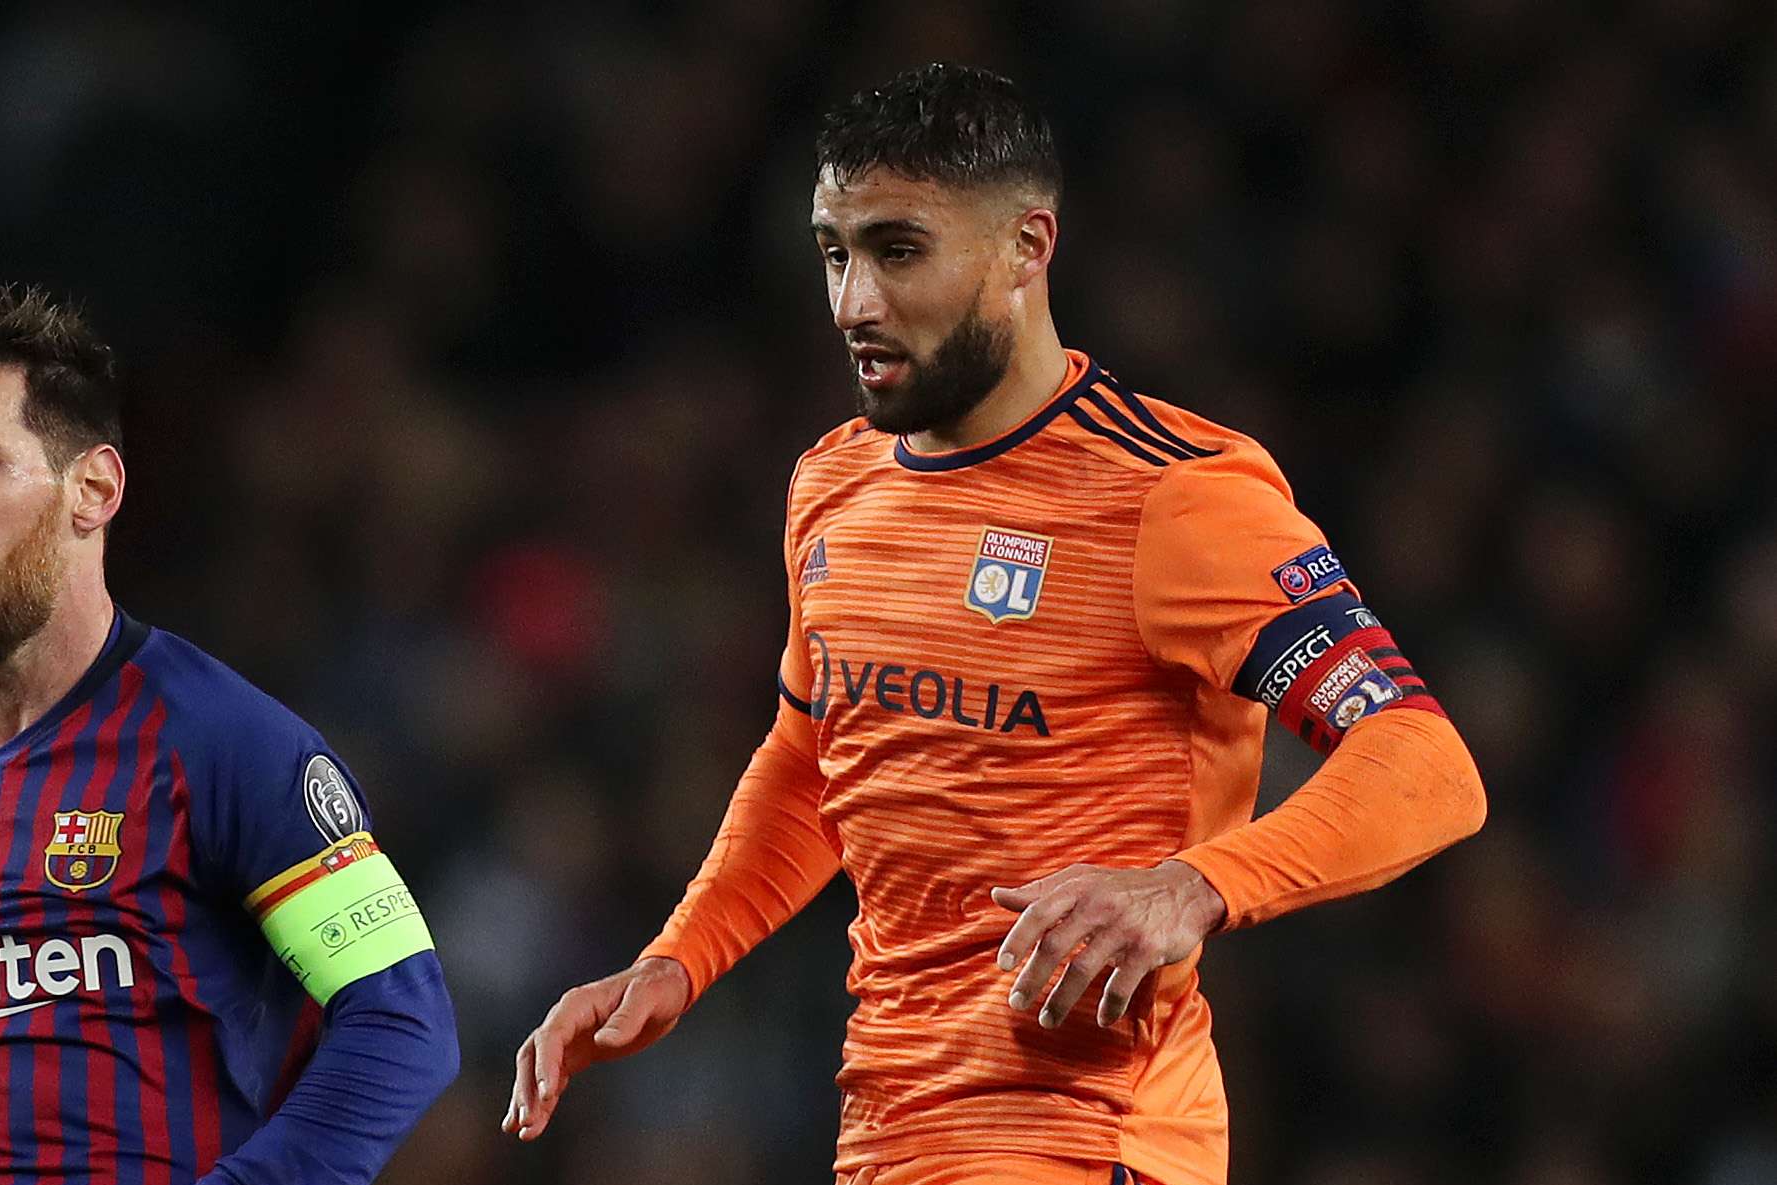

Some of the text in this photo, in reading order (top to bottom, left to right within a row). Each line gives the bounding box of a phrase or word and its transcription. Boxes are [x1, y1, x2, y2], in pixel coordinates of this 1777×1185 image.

[982, 543, 1044, 565] LYONNAIS
[986, 531, 1047, 554] OLYMPIQUE
[1261, 628, 1335, 709] RESPECT
[839, 659, 1051, 737] VEOLIA
[333, 799, 348, 825] 5
